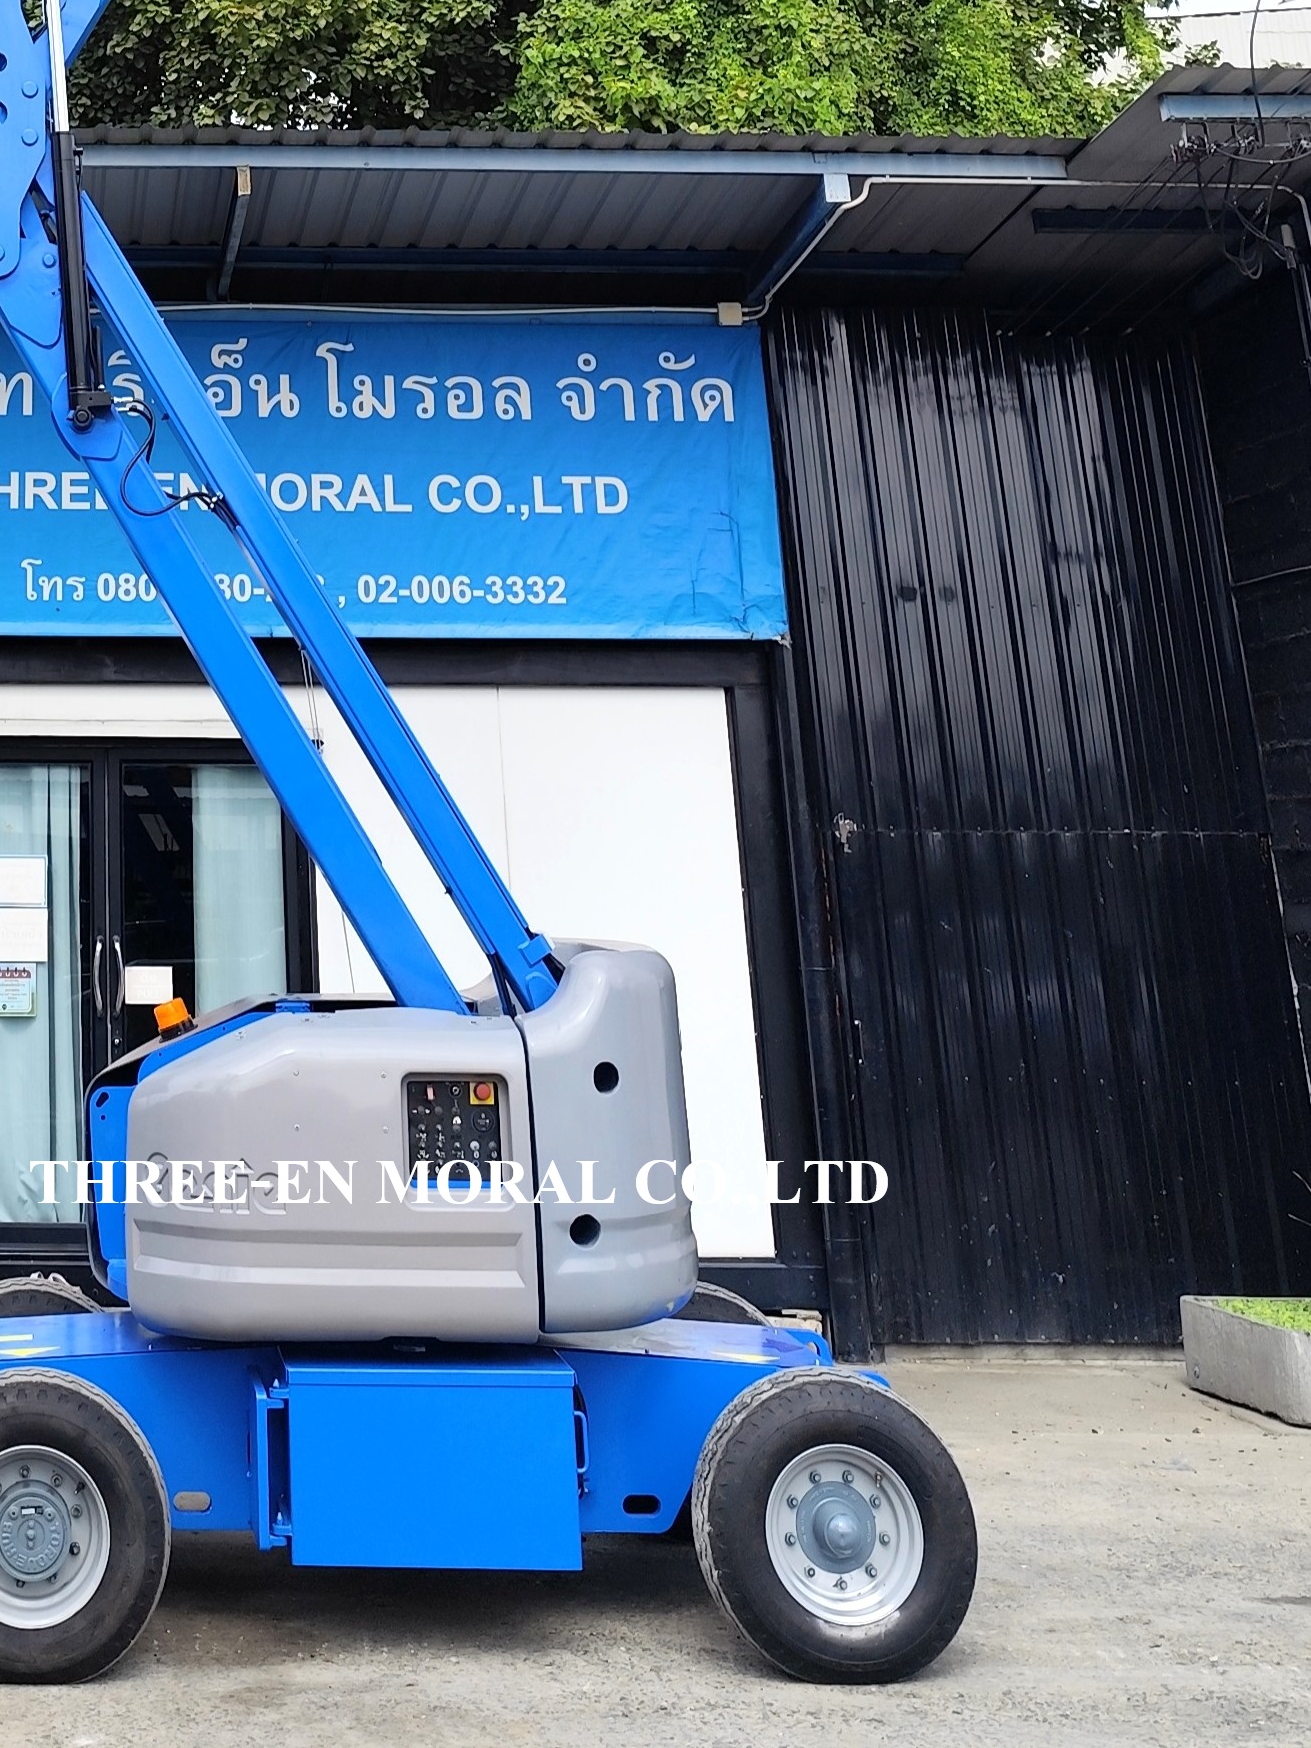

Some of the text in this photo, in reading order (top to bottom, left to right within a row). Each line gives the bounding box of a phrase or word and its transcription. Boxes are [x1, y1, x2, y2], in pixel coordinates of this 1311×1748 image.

[316, 342, 532, 421] โมรอล
[556, 352, 735, 422] จำกัด
[255, 473, 412, 513] ORAL
[428, 474, 629, 521] CO.,LTD
[21, 558, 86, 602] โทร
[357, 574, 567, 605] 02-006-3332
